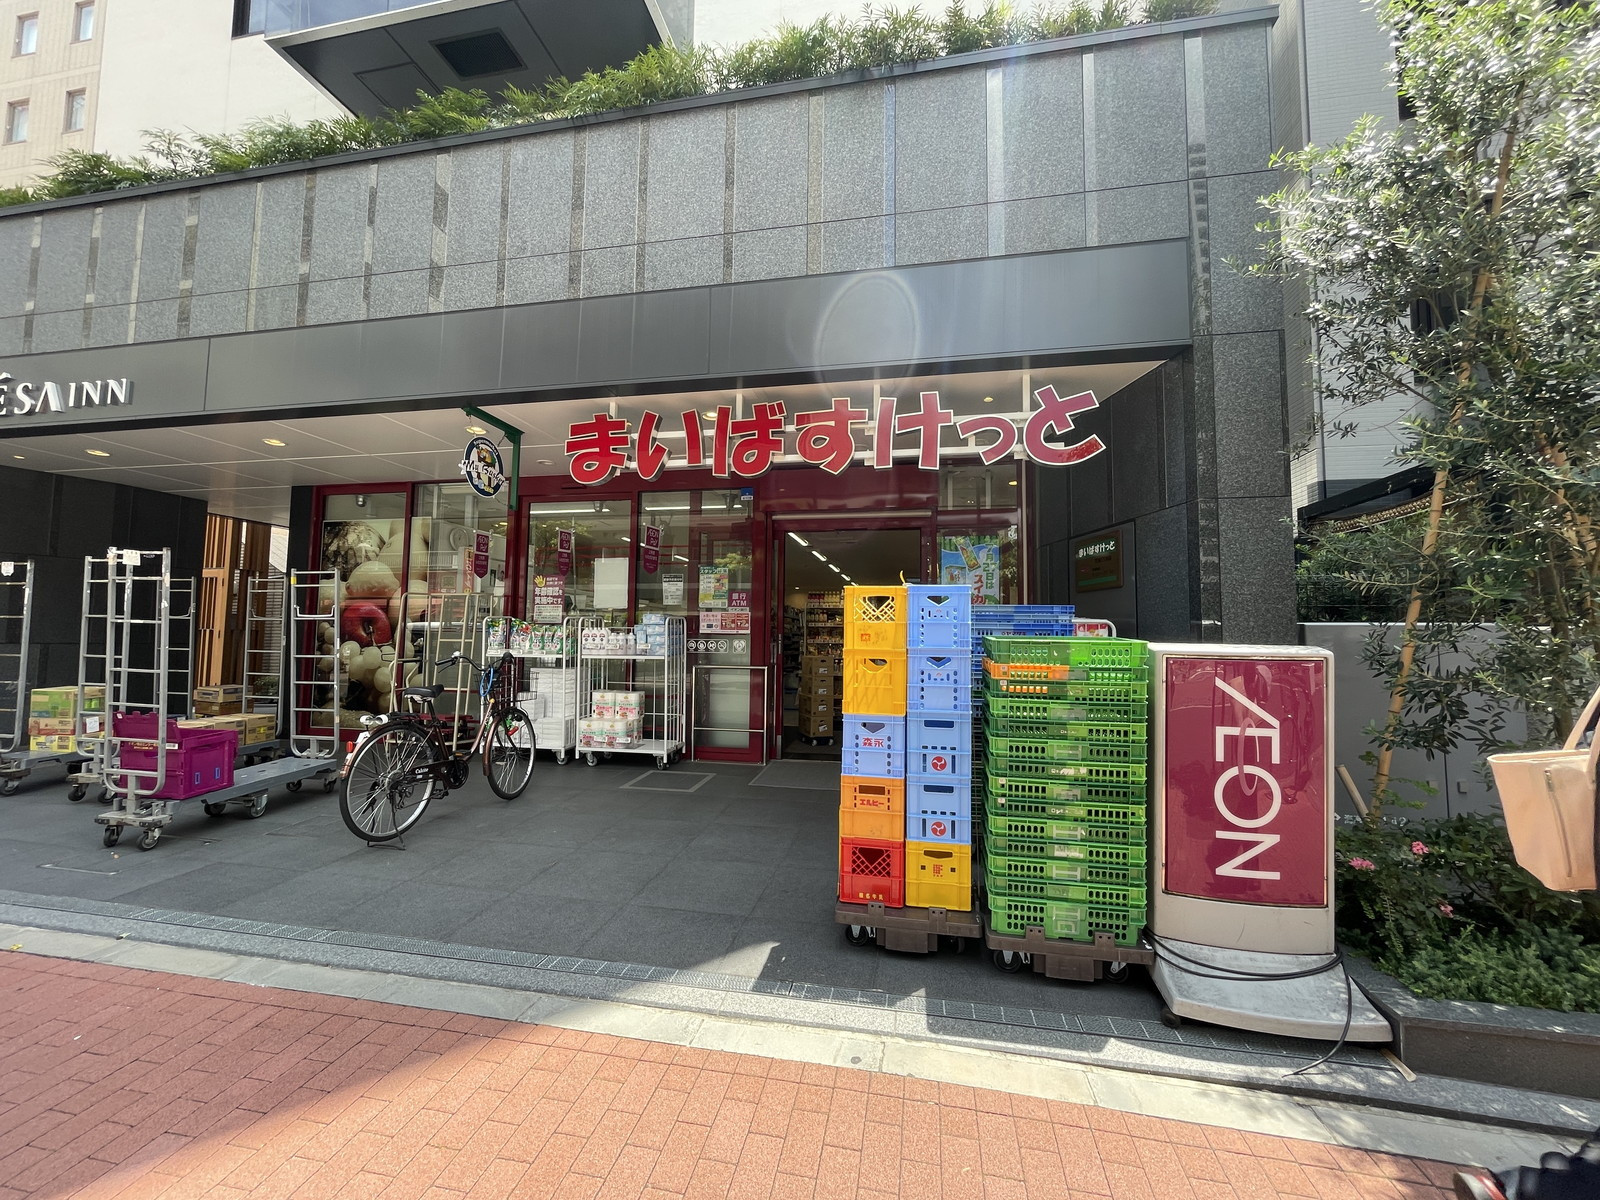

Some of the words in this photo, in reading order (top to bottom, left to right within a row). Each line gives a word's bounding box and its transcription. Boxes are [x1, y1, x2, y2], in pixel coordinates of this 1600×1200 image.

[69, 378, 128, 407] INN
[564, 384, 1107, 486] まいばすけっと
[1078, 540, 1116, 558] まいばすけっと
[534, 586, 563, 596] 年齢確認を
[732, 592, 746, 600] 銀行
[862, 737, 885, 748] 森永
[1213, 676, 1282, 881] AEON
